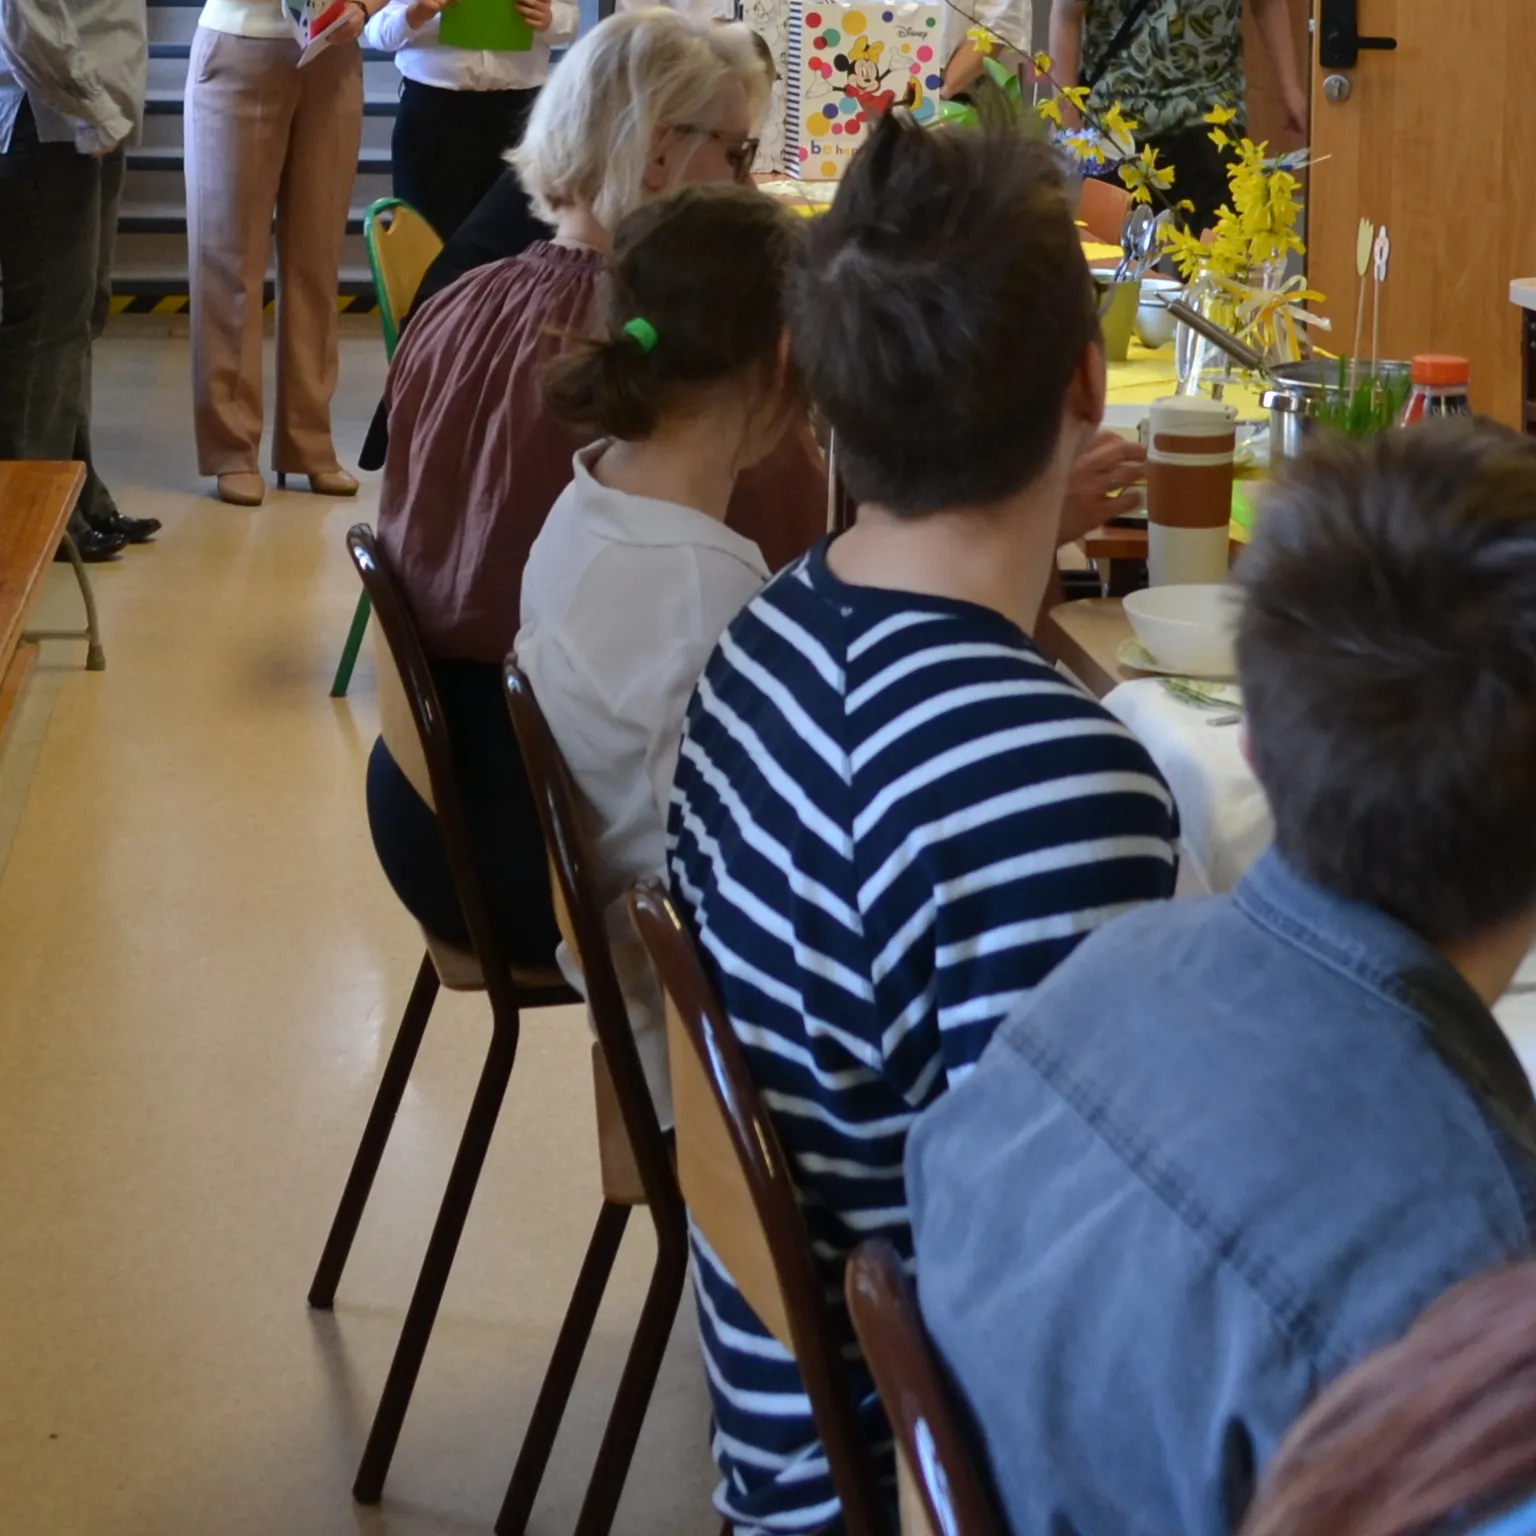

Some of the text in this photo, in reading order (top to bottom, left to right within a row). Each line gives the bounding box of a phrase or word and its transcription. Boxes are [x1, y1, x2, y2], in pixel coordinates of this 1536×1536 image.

[894, 24, 929, 40] Disney
[810, 139, 858, 158] be hap
